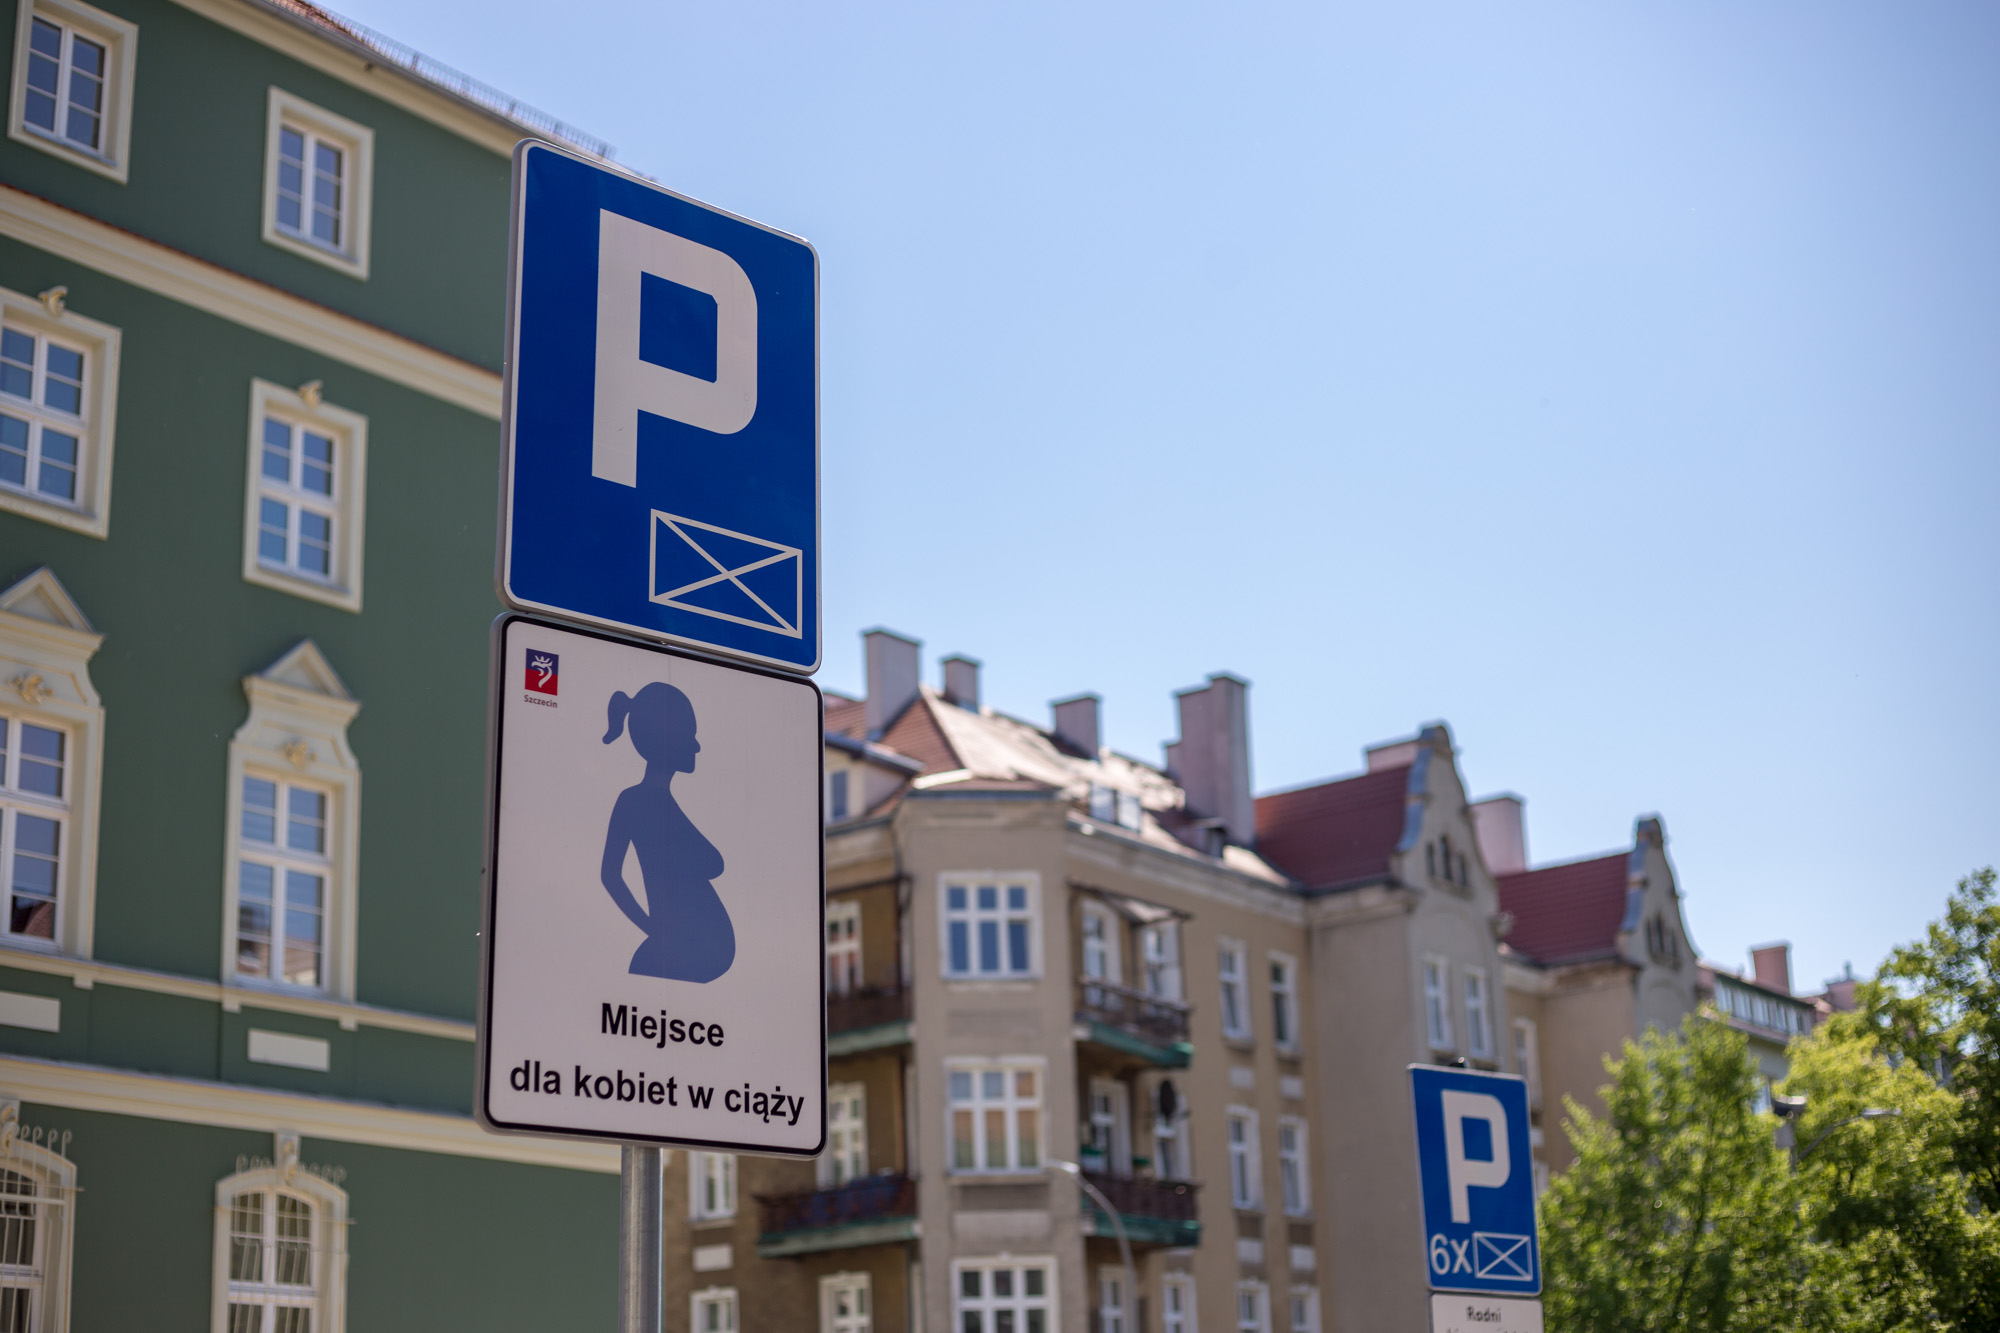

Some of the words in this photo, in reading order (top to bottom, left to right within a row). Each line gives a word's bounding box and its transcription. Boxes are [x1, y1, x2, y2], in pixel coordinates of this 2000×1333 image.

[592, 208, 758, 489] P
[524, 694, 558, 709] Szczecin
[601, 1002, 725, 1049] Miejsce
[509, 1060, 562, 1095] dla
[574, 1065, 678, 1107] kobiet
[687, 1084, 715, 1110] w
[724, 1083, 805, 1126] ciąży
[1440, 1088, 1511, 1225] P
